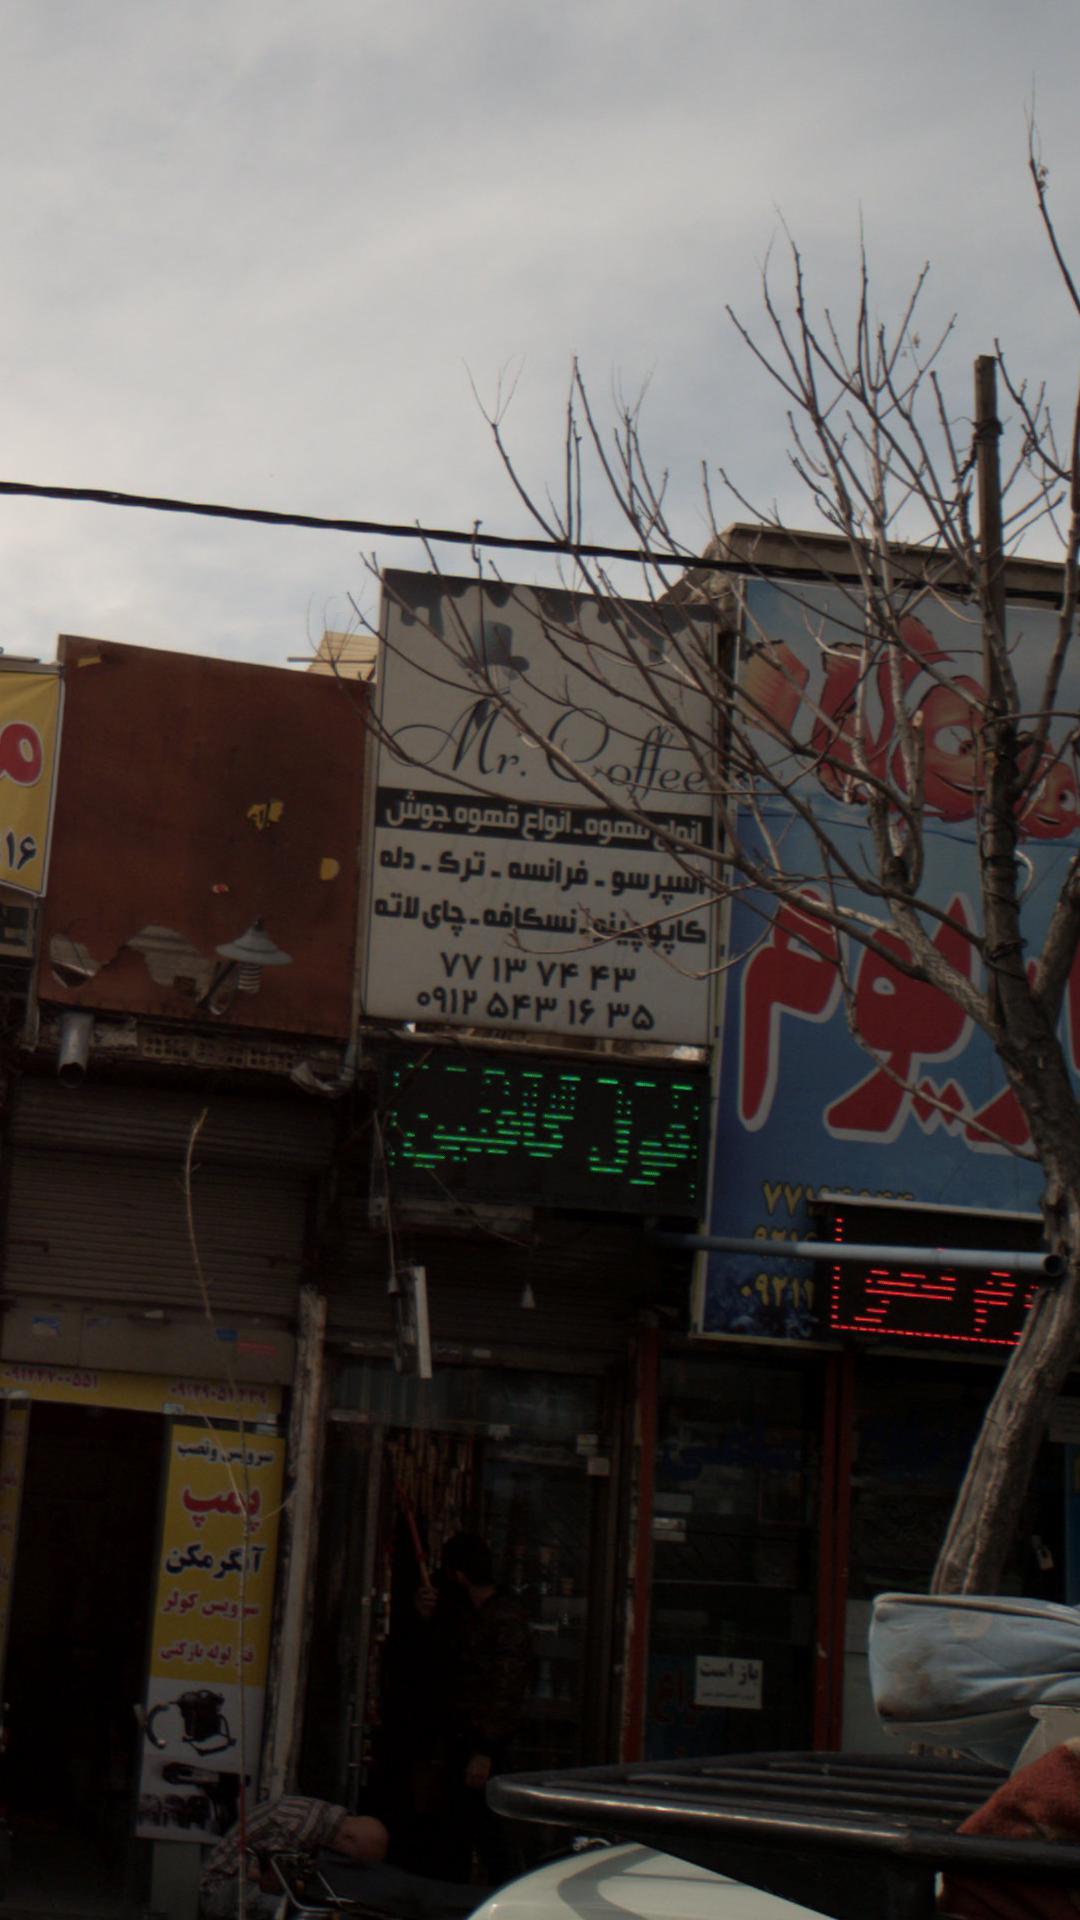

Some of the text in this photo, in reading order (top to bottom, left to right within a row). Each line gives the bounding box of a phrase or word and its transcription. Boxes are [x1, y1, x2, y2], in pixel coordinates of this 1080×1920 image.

[388, 697, 705, 801] Mr. Coffee
[385, 789, 452, 828] جوش
[454, 803, 520, 834] قهوه
[521, 807, 573, 841] انواع
[380, 846, 416, 869] دله
[438, 850, 486, 882] ترک
[508, 857, 589, 892] فرانسه
[611, 869, 705, 906] اسپرسو
[375, 892, 420, 920] لاته
[422, 900, 466, 937] چای
[483, 902, 577, 935] نسکافه
[183, 1487, 260, 1532] پمپ
